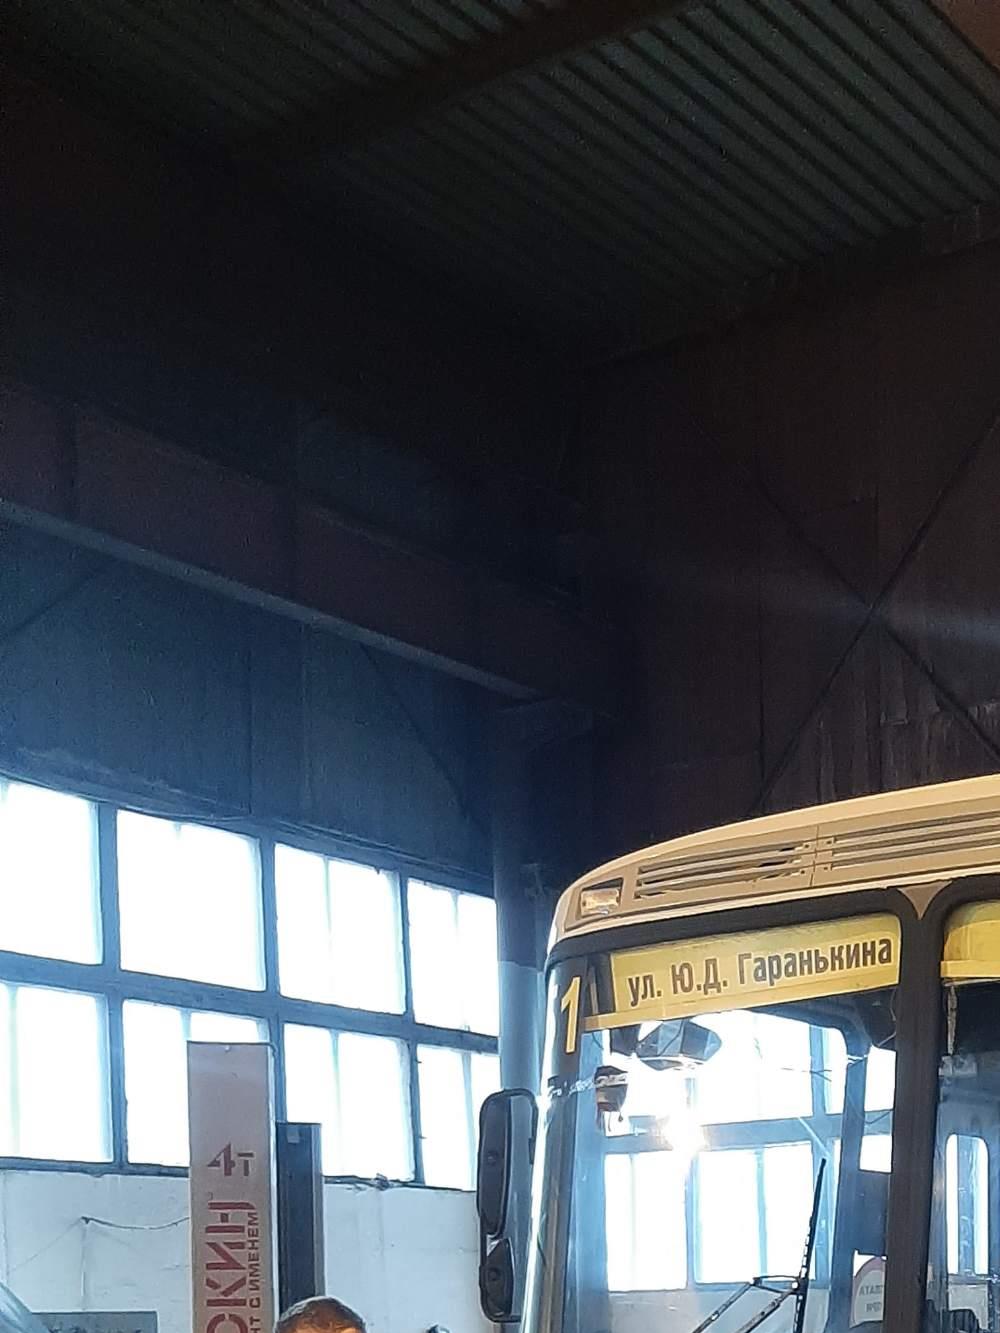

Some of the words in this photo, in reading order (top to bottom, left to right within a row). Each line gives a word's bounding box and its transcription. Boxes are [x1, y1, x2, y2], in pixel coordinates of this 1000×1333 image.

[628, 973, 662, 1006] ул.
[671, 958, 728, 996] Ю.Д.
[738, 937, 893, 984] Гаранькина
[560, 976, 581, 1053] 1
[247, 1212, 261, 1292] ИМЕНЕМ
[249, 1297, 261, 1308] С
